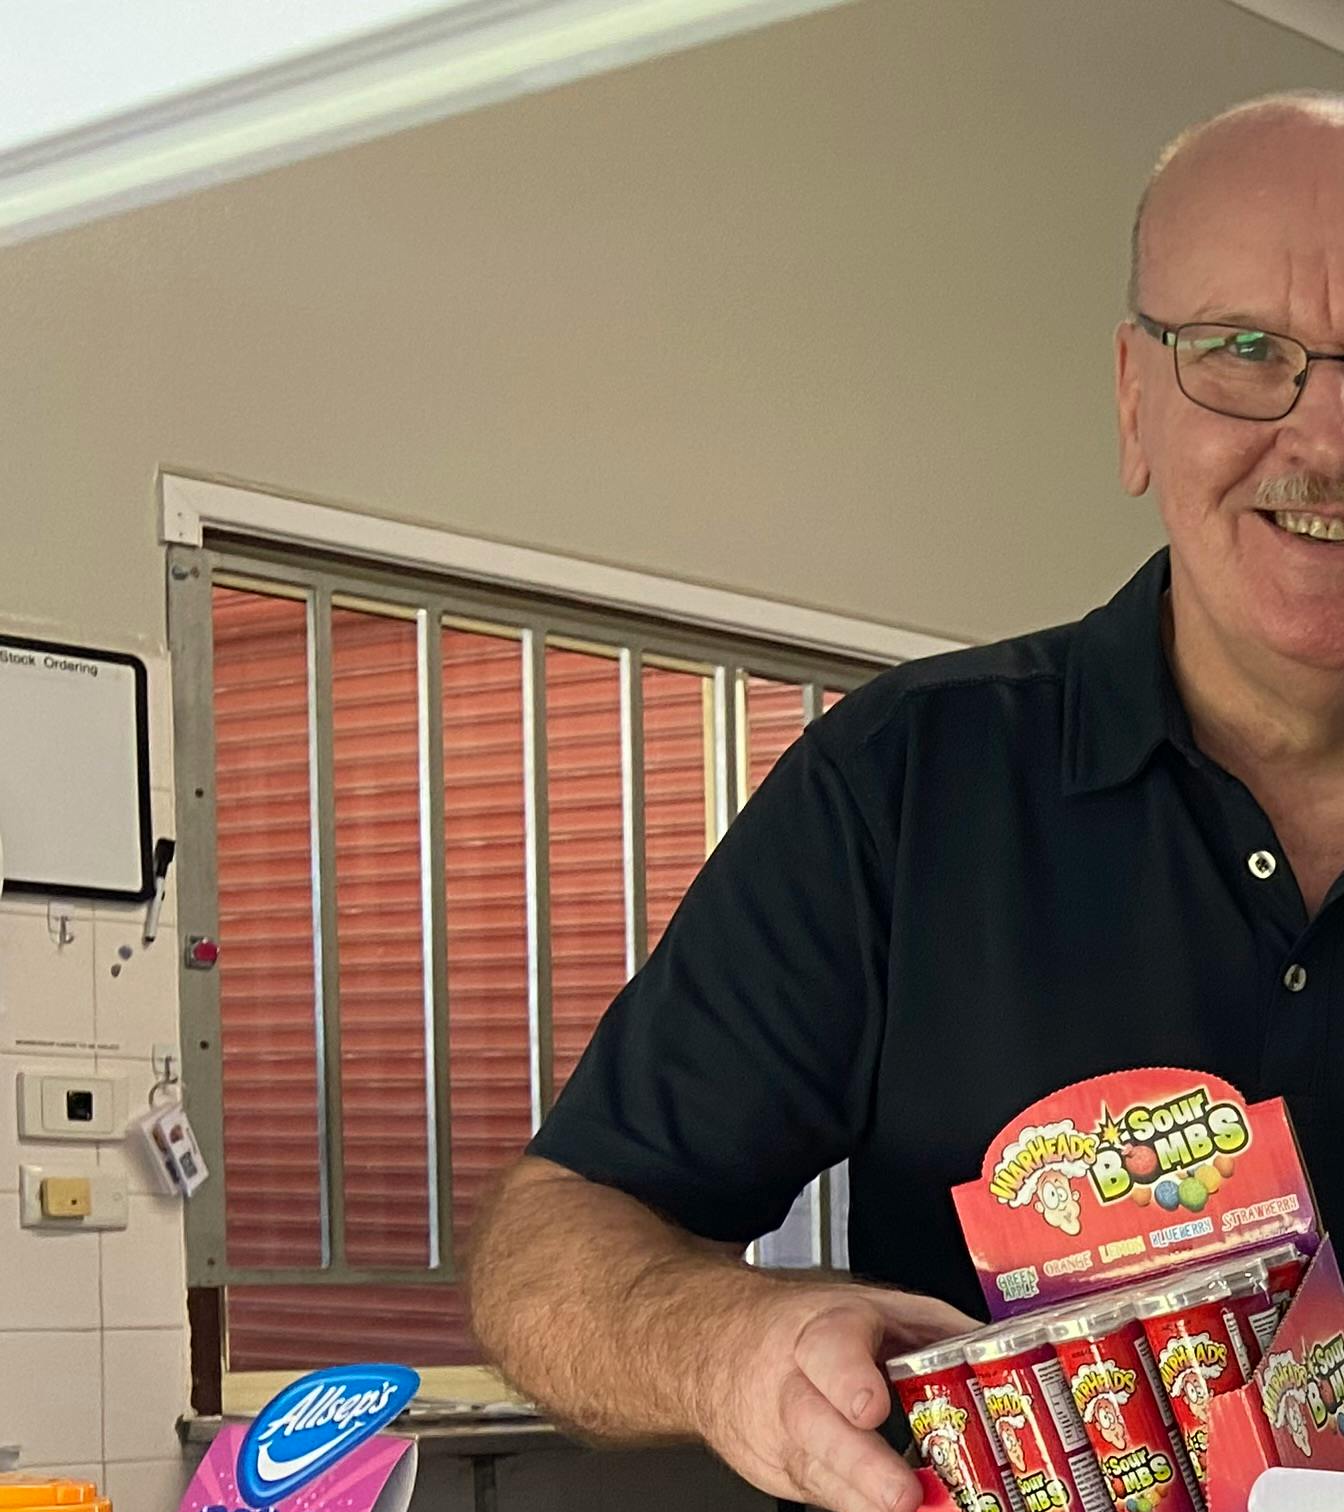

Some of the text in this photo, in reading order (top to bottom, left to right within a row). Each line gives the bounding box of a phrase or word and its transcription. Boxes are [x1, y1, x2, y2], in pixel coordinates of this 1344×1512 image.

[44, 656, 98, 677] Ordering
[1126, 1091, 1209, 1142] Sour
[990, 1133, 1098, 1200] WARHEADS
[1223, 1196, 1297, 1230] STRAWBERRY
[1151, 1219, 1212, 1246] BLUEBERRY
[1044, 1251, 1092, 1276] ORANGE
[259, 1379, 398, 1440] Allsep's
